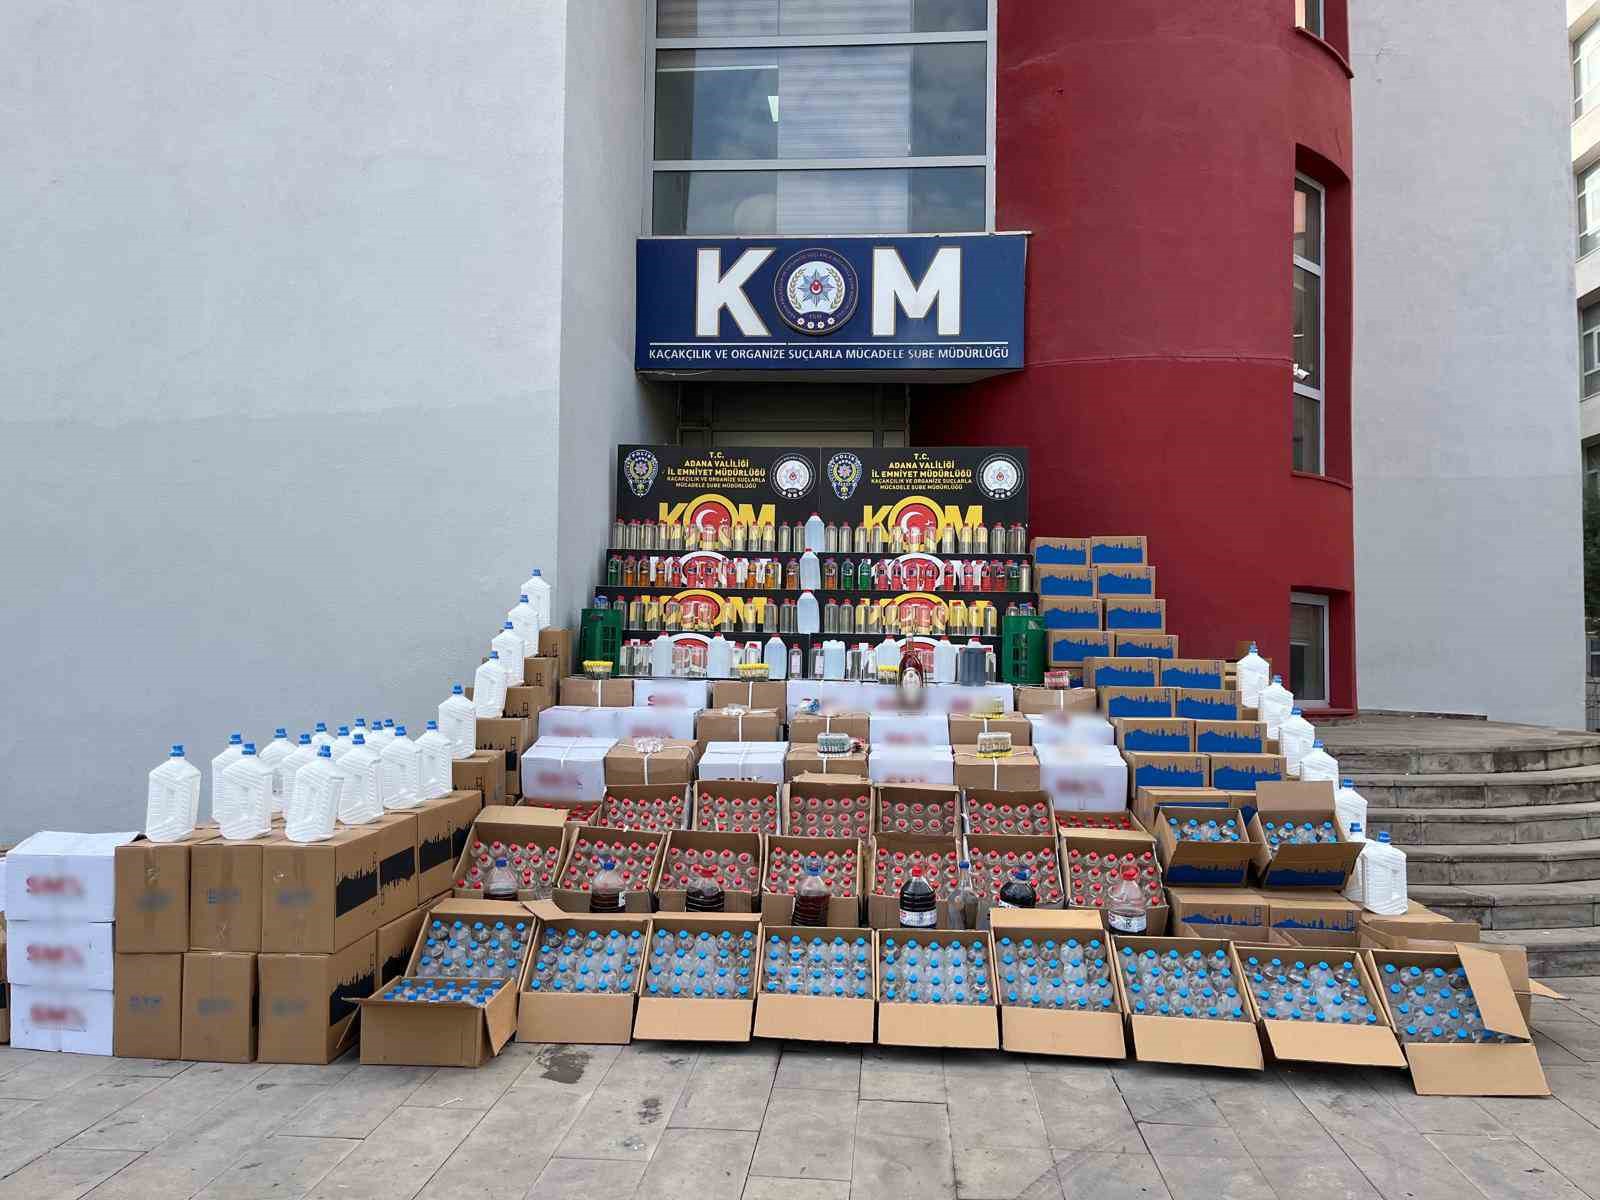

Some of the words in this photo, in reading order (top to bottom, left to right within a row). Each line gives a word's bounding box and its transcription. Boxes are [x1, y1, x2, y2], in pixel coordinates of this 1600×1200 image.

[715, 349, 728, 359] VE
[731, 347, 785, 359] ORGANİZE
[788, 348, 843, 361] SUÇLARLA
[845, 346, 905, 359] MÜCADELE
[938, 346, 1009, 359] MÜDÜRLÜĞÜ
[709, 451, 725, 459] T.C.
[913, 452, 930, 460] T.C.
[667, 467, 676, 476] İL
[677, 467, 713, 476] EMNİYET
[715, 468, 766, 477] MÜDÜRLÜĞÜ
[871, 469, 880, 478] İL
[881, 469, 918, 478] EMNİYET
[919, 469, 972, 478] MÜDÜRLÜĞÜ
